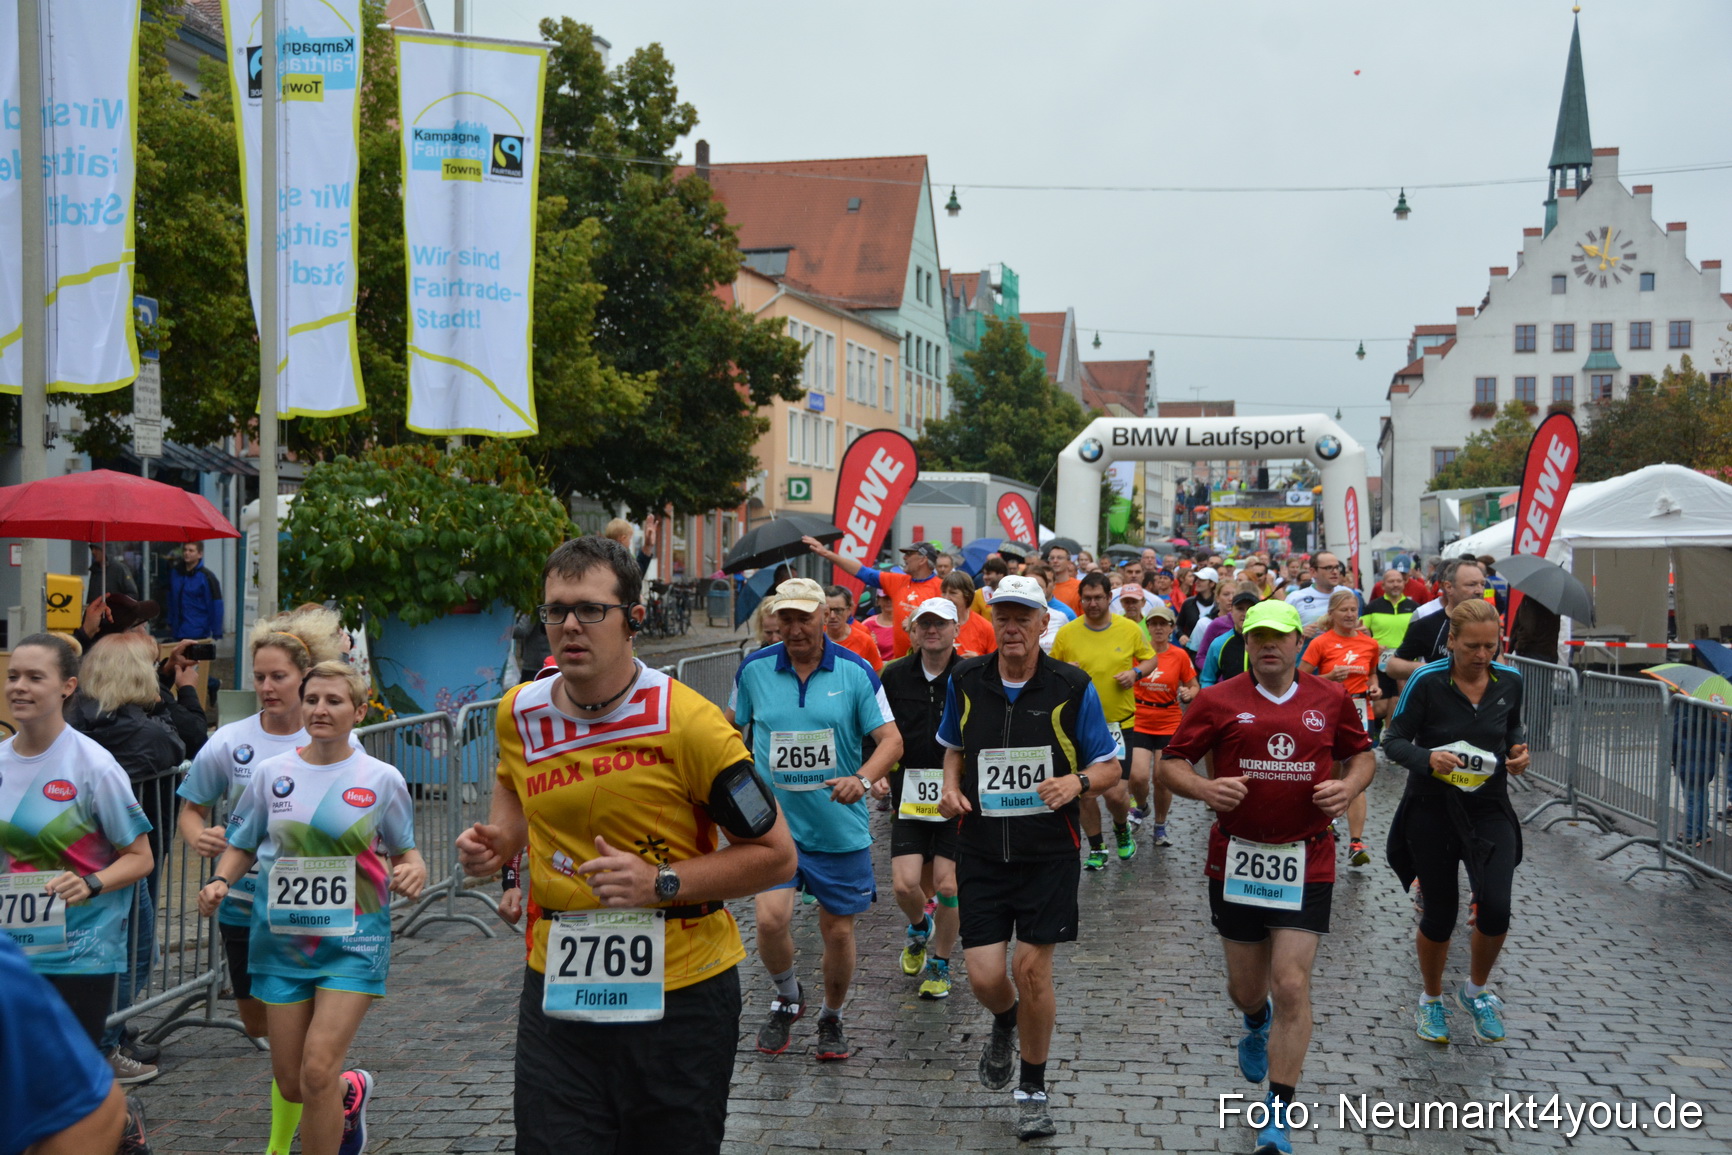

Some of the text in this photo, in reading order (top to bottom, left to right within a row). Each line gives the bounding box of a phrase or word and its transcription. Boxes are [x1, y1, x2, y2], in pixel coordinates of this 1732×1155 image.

[414, 130, 480, 144] Kampagne
[415, 142, 487, 159] Fairtrade
[444, 163, 481, 176] Towns
[413, 245, 500, 270] Wir sind
[413, 276, 522, 302] Fairtrade-
[417, 308, 481, 329] Stadt!
[1112, 425, 1306, 450] BMW Laufsport
[790, 480, 808, 498] D
[1518, 433, 1571, 555] REWE
[838, 446, 905, 563] REWE
[1003, 501, 1032, 544] EWE
[1251, 510, 1274, 519] ZIEL
[776, 744, 831, 769] 2654
[1239, 758, 1316, 772] NÜRNBERGER
[526, 746, 675, 798] MAX BÖGL
[783, 774, 825, 784] Wolfgang
[987, 763, 1046, 790] 2464
[1242, 770, 1312, 781] VERSICHERUNG
[1451, 774, 1469, 785] Elke
[1001, 796, 1034, 807] Hubert
[304, 860, 347, 869] BOCK
[1234, 851, 1298, 883] 2636
[277, 875, 347, 905] 2266
[1243, 884, 1284, 899] Michael
[0, 893, 57, 924] 707
[289, 913, 331, 925] Simone
[342, 935, 386, 943] Neumarkter
[342, 944, 379, 953] Stadtlauf
[558, 934, 653, 977] 2769
[575, 989, 628, 1006] Florian
